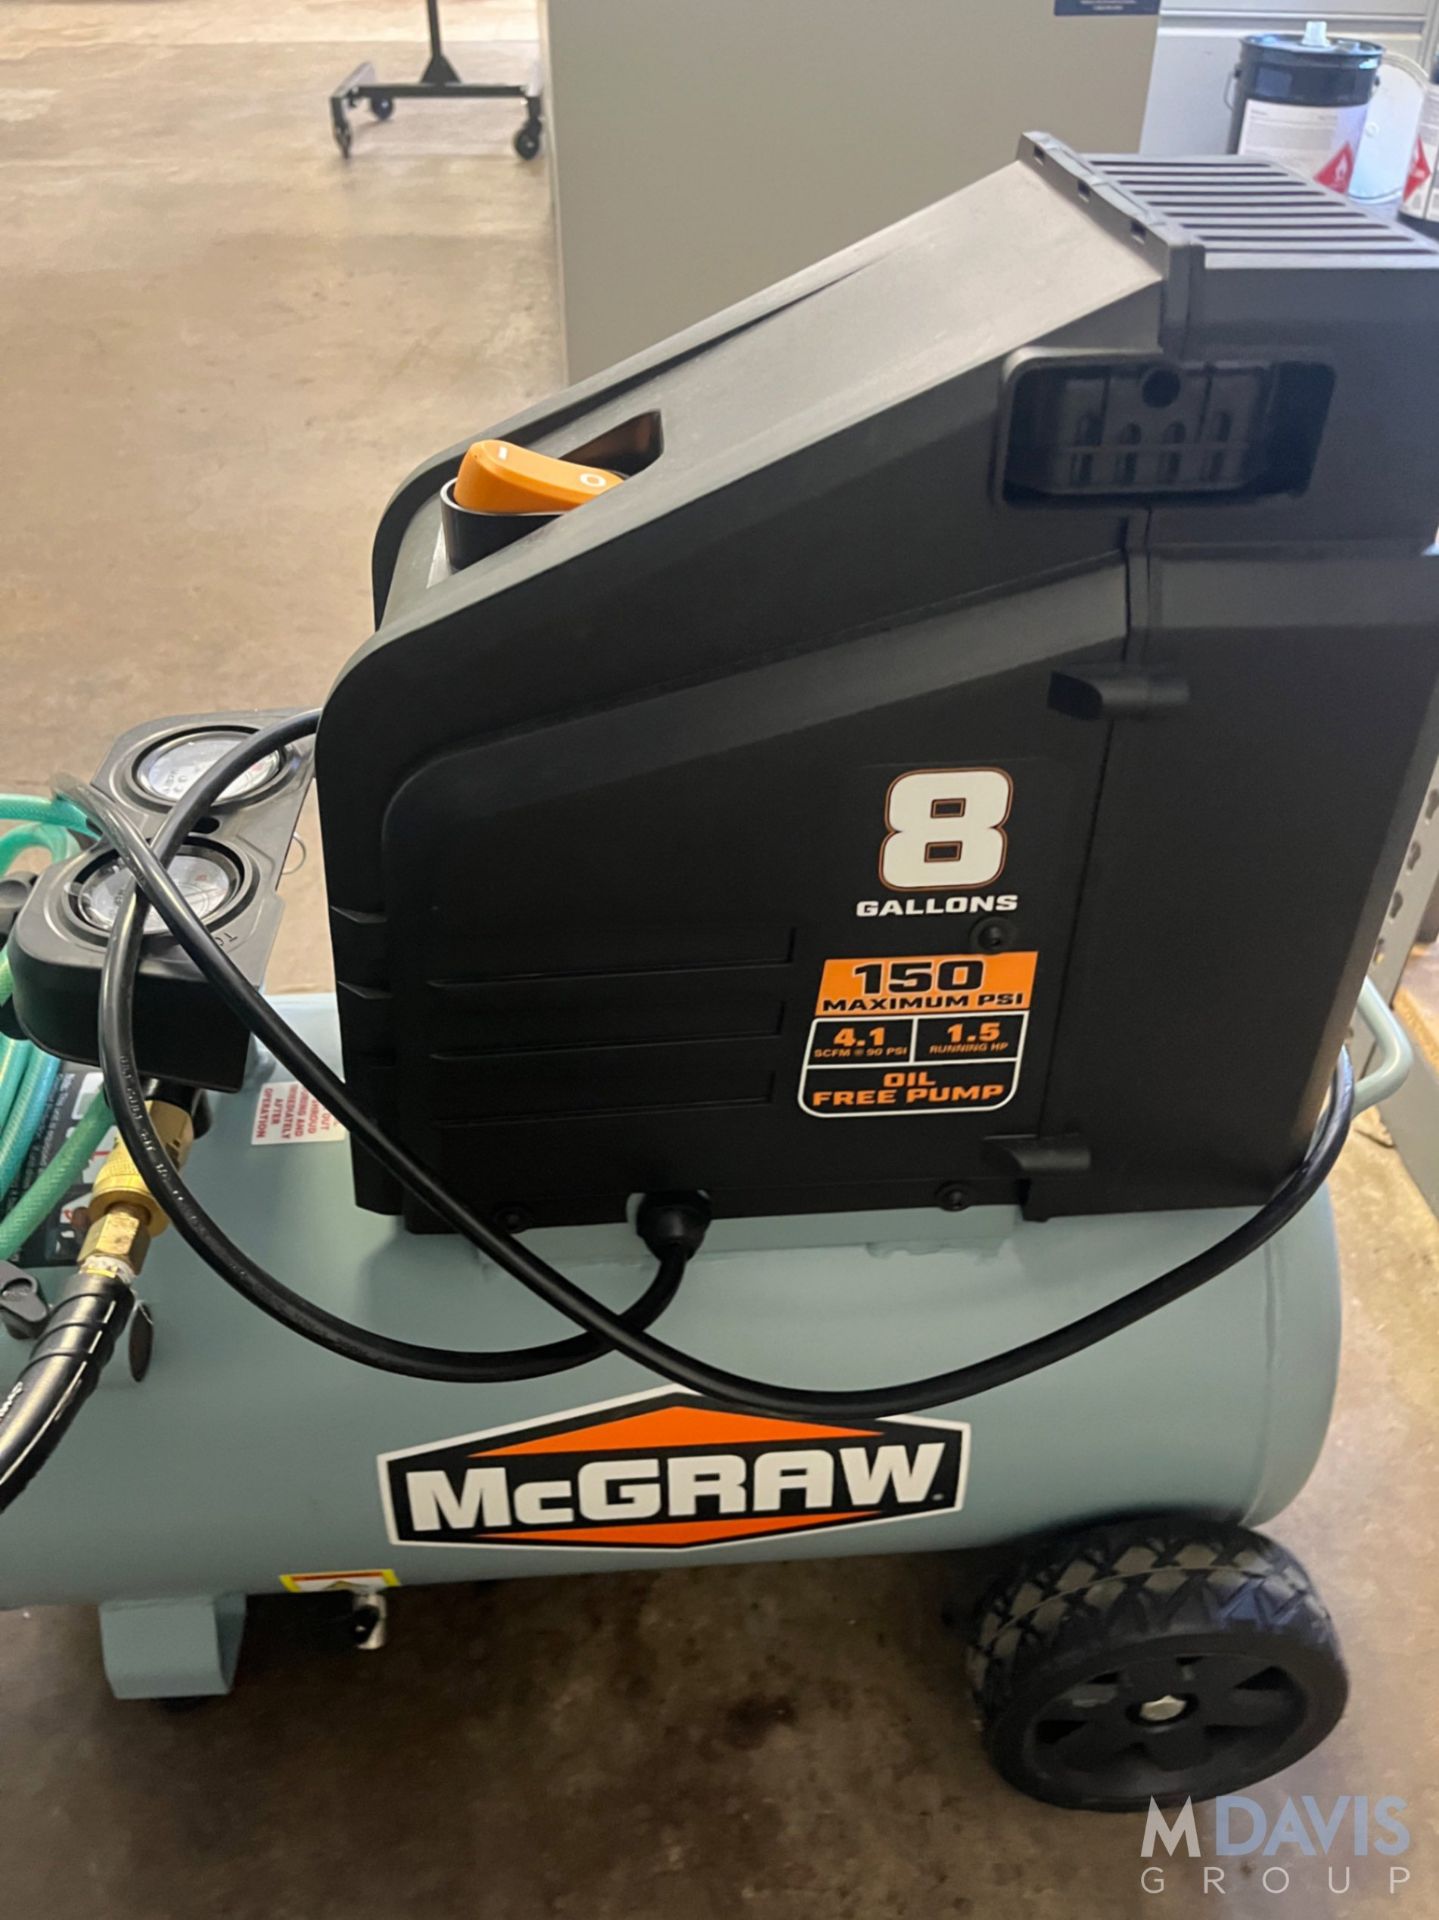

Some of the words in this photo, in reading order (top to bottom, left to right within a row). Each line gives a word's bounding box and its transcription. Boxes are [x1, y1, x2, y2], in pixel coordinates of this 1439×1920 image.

[878, 766, 1014, 892] 8
[855, 894, 1019, 918] GALLONS
[853, 959, 985, 995] 150
[822, 994, 969, 1012] MAXIMUM
[976, 993, 1024, 1007] PSI
[833, 1026, 886, 1047] 4.1
[946, 1022, 1001, 1043] 1.5
[814, 1048, 851, 1058] SCFM
[866, 1047, 883, 1057] 90
[886, 1046, 908, 1056] PSI
[929, 1042, 987, 1055] RUNNING
[990, 1041, 1009, 1051] HP
[883, 1071, 937, 1088] OIL
[812, 1089, 898, 1107] FREE
[906, 1084, 1005, 1104] PUMP
[256, 1087, 274, 1138] OPERATION
[270, 1098, 284, 1125] AFTER
[405, 1442, 947, 1532] McGRAW
